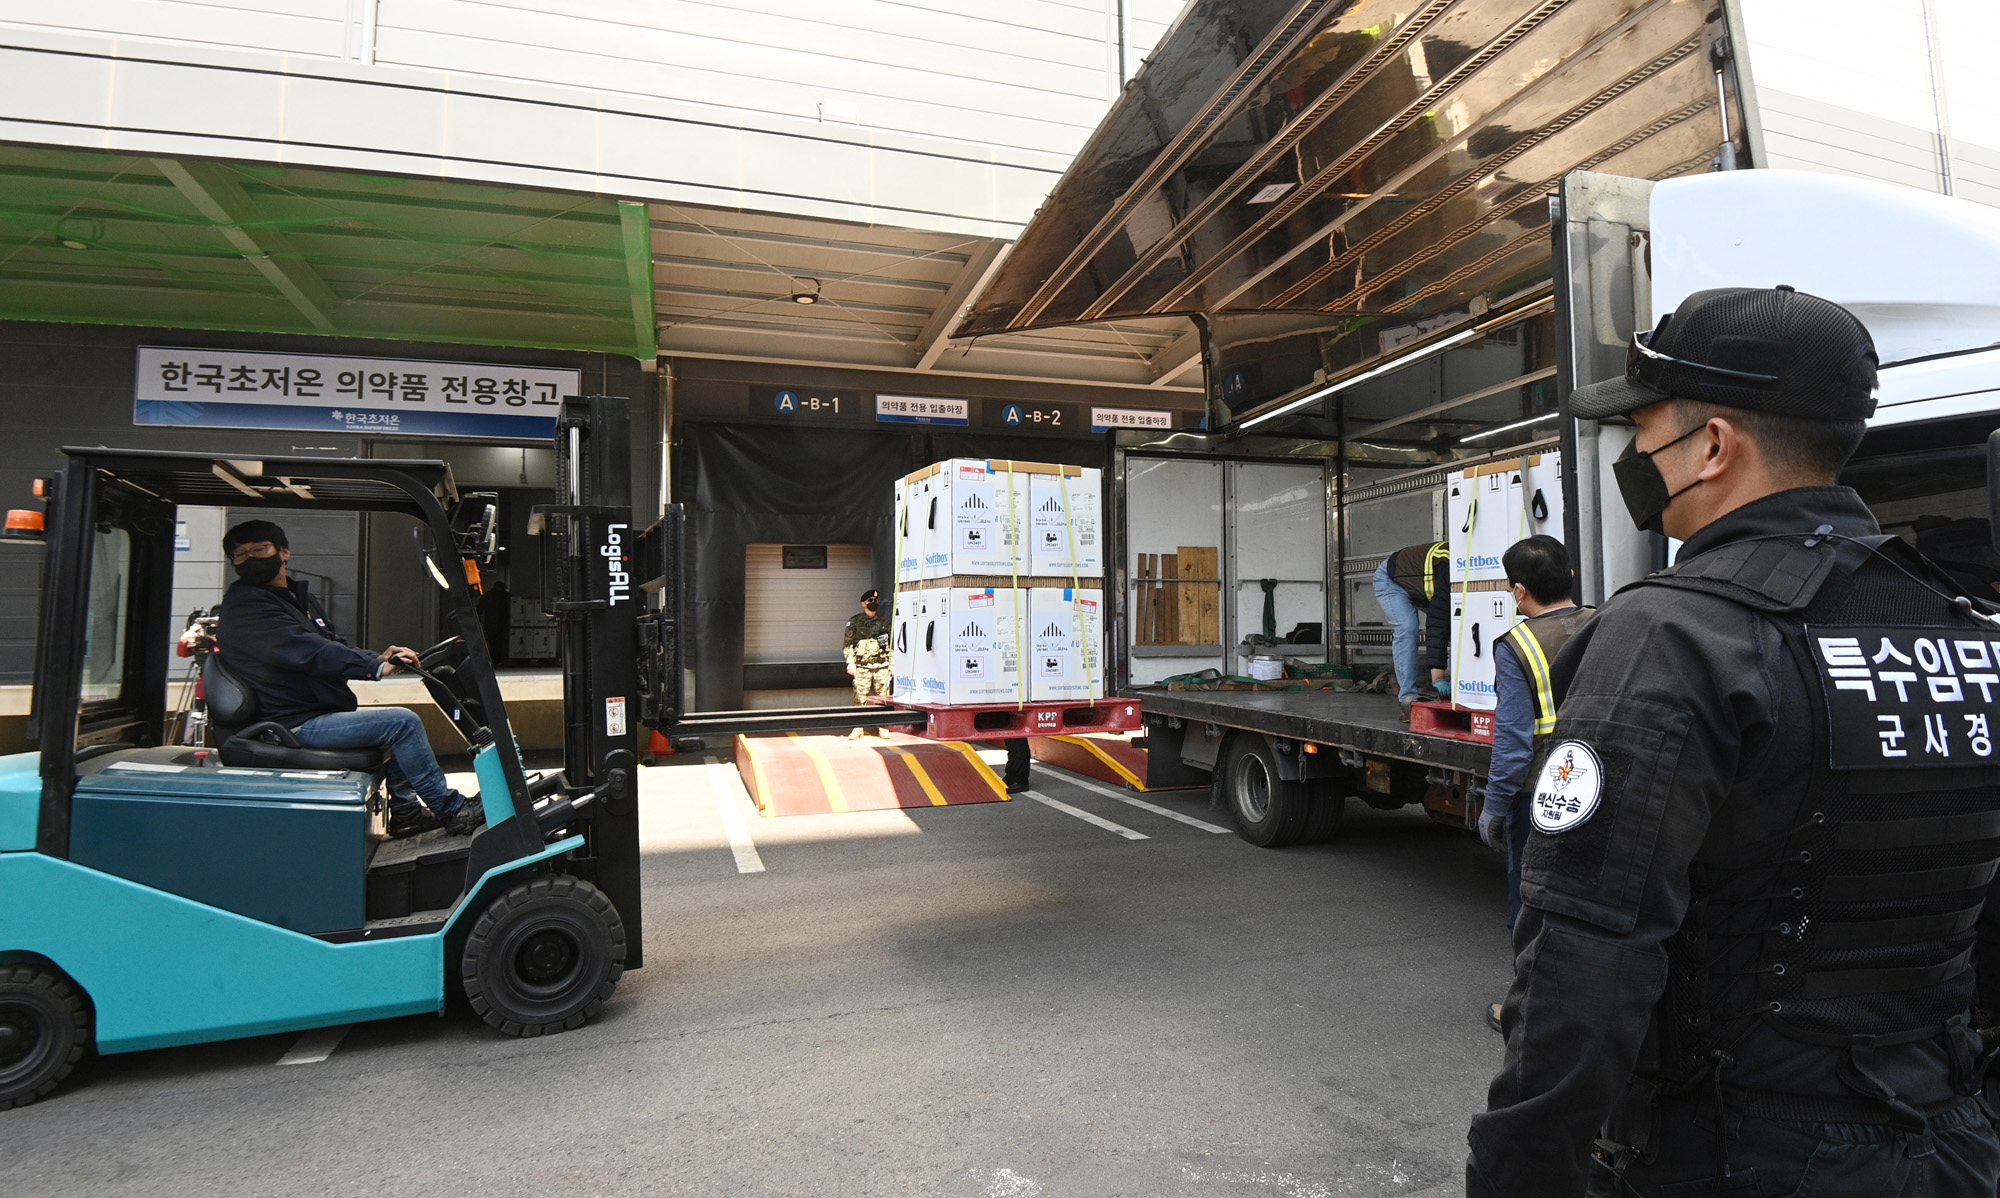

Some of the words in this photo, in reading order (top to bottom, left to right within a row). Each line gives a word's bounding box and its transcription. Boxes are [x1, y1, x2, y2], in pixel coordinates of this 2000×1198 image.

[160, 361, 324, 397] 한국초저온
[335, 370, 429, 402] 의약품
[441, 376, 560, 407] 전용창고
[881, 401, 908, 412] 의약품
[910, 402, 927, 413] 전용
[929, 403, 963, 415] 입출하장
[345, 412, 400, 426] 한국초저온
[1096, 413, 1119, 424] 의약품
[1121, 414, 1136, 425] 전용
[1138, 415, 1167, 426] 입출하장
[600, 523, 630, 606] LogisALL
[900, 557, 918, 569] oftbox
[925, 552, 948, 565] Softbox
[1817, 637, 2000, 703] 특수임무
[922, 677, 946, 691] Softbox
[1458, 679, 1496, 693] Softbo
[1037, 711, 1058, 721] KPP
[1473, 716, 1491, 726] KPP
[1537, 792, 1582, 814] 백신수송
